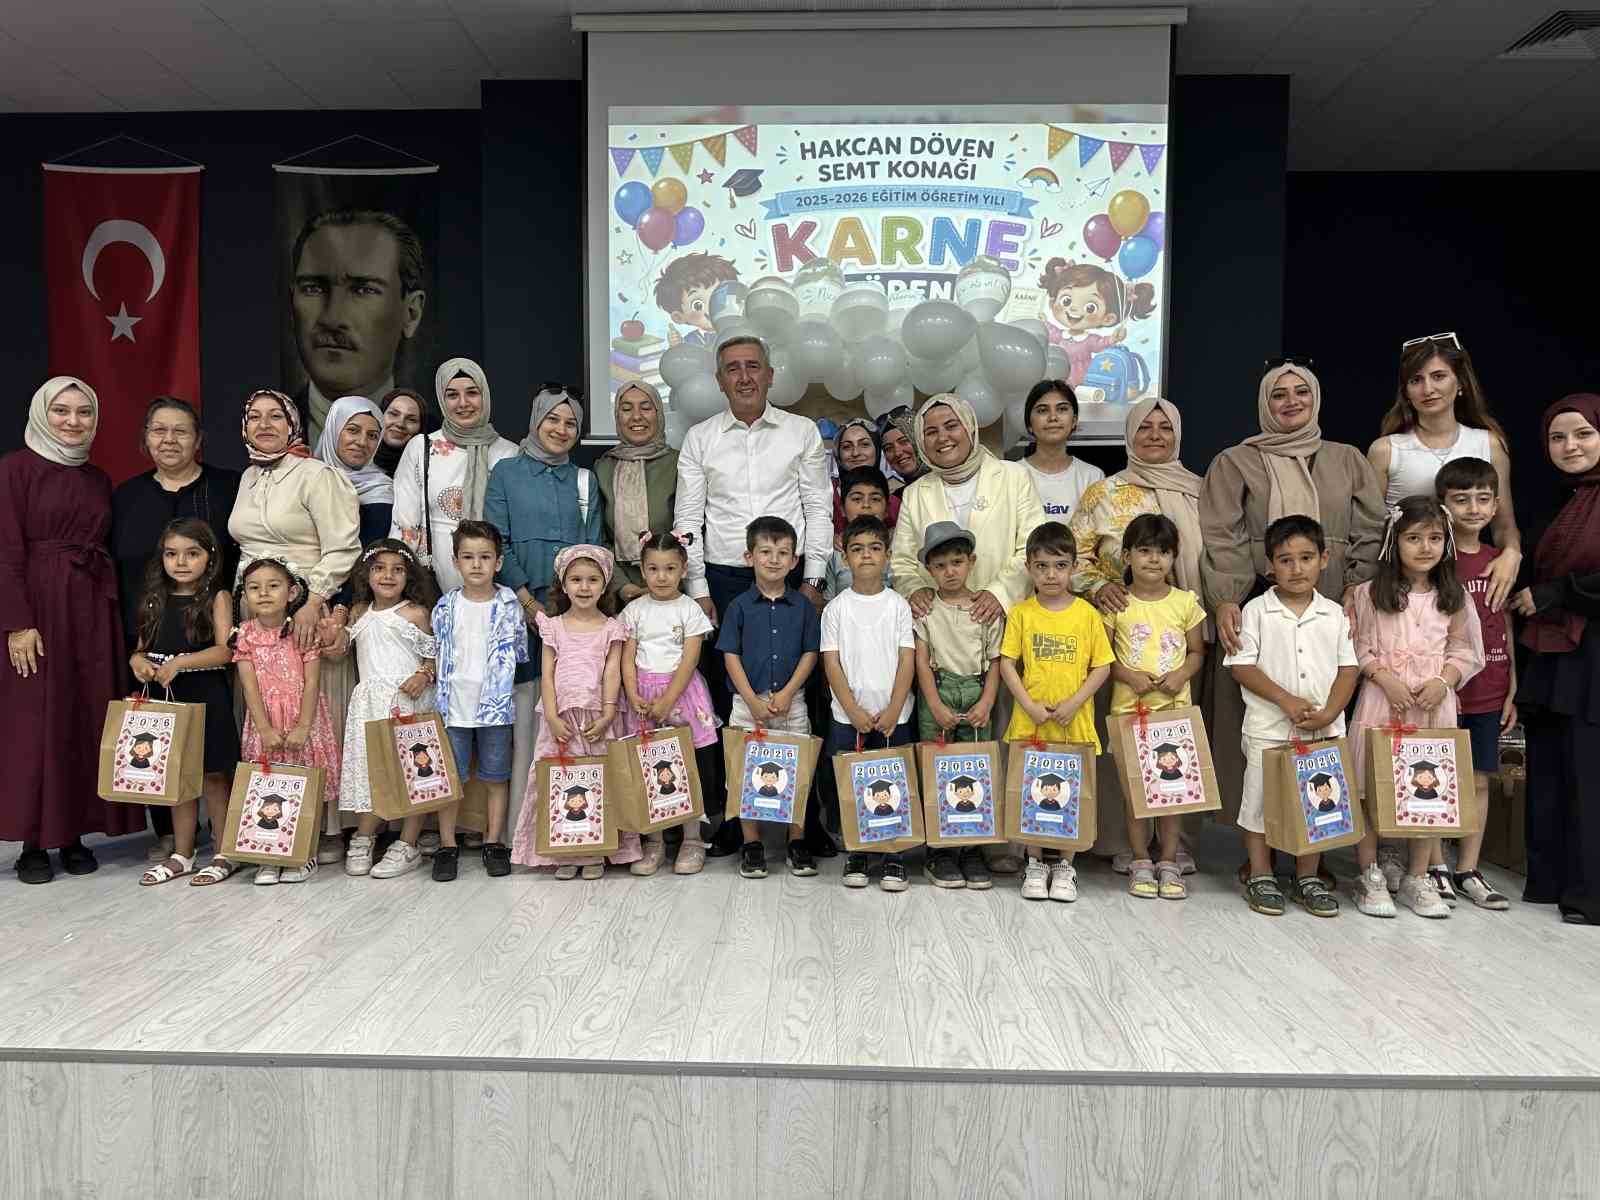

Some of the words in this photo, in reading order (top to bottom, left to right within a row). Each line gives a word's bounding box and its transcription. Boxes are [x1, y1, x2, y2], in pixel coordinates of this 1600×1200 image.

[799, 136, 902, 161] HAKCAN
[909, 132, 995, 159] DÖVEN
[818, 160, 880, 183] SEMT
[887, 158, 977, 181] KONAĞI
[795, 192, 868, 207] 2025-2026
[872, 189, 917, 202] EĞİTİM
[920, 190, 979, 204] ÖĞRETİM
[982, 194, 1005, 207] YILI
[771, 216, 1027, 272] KARNE
[128, 716, 170, 728] 2026
[750, 745, 793, 758] 2026
[940, 760, 985, 771] 2026
[1030, 756, 1076, 769] 2026
[1298, 752, 1336, 769] 2026
[555, 770, 598, 780] 2026
[857, 762, 901, 776] 2026
[254, 777, 301, 790] 2026
